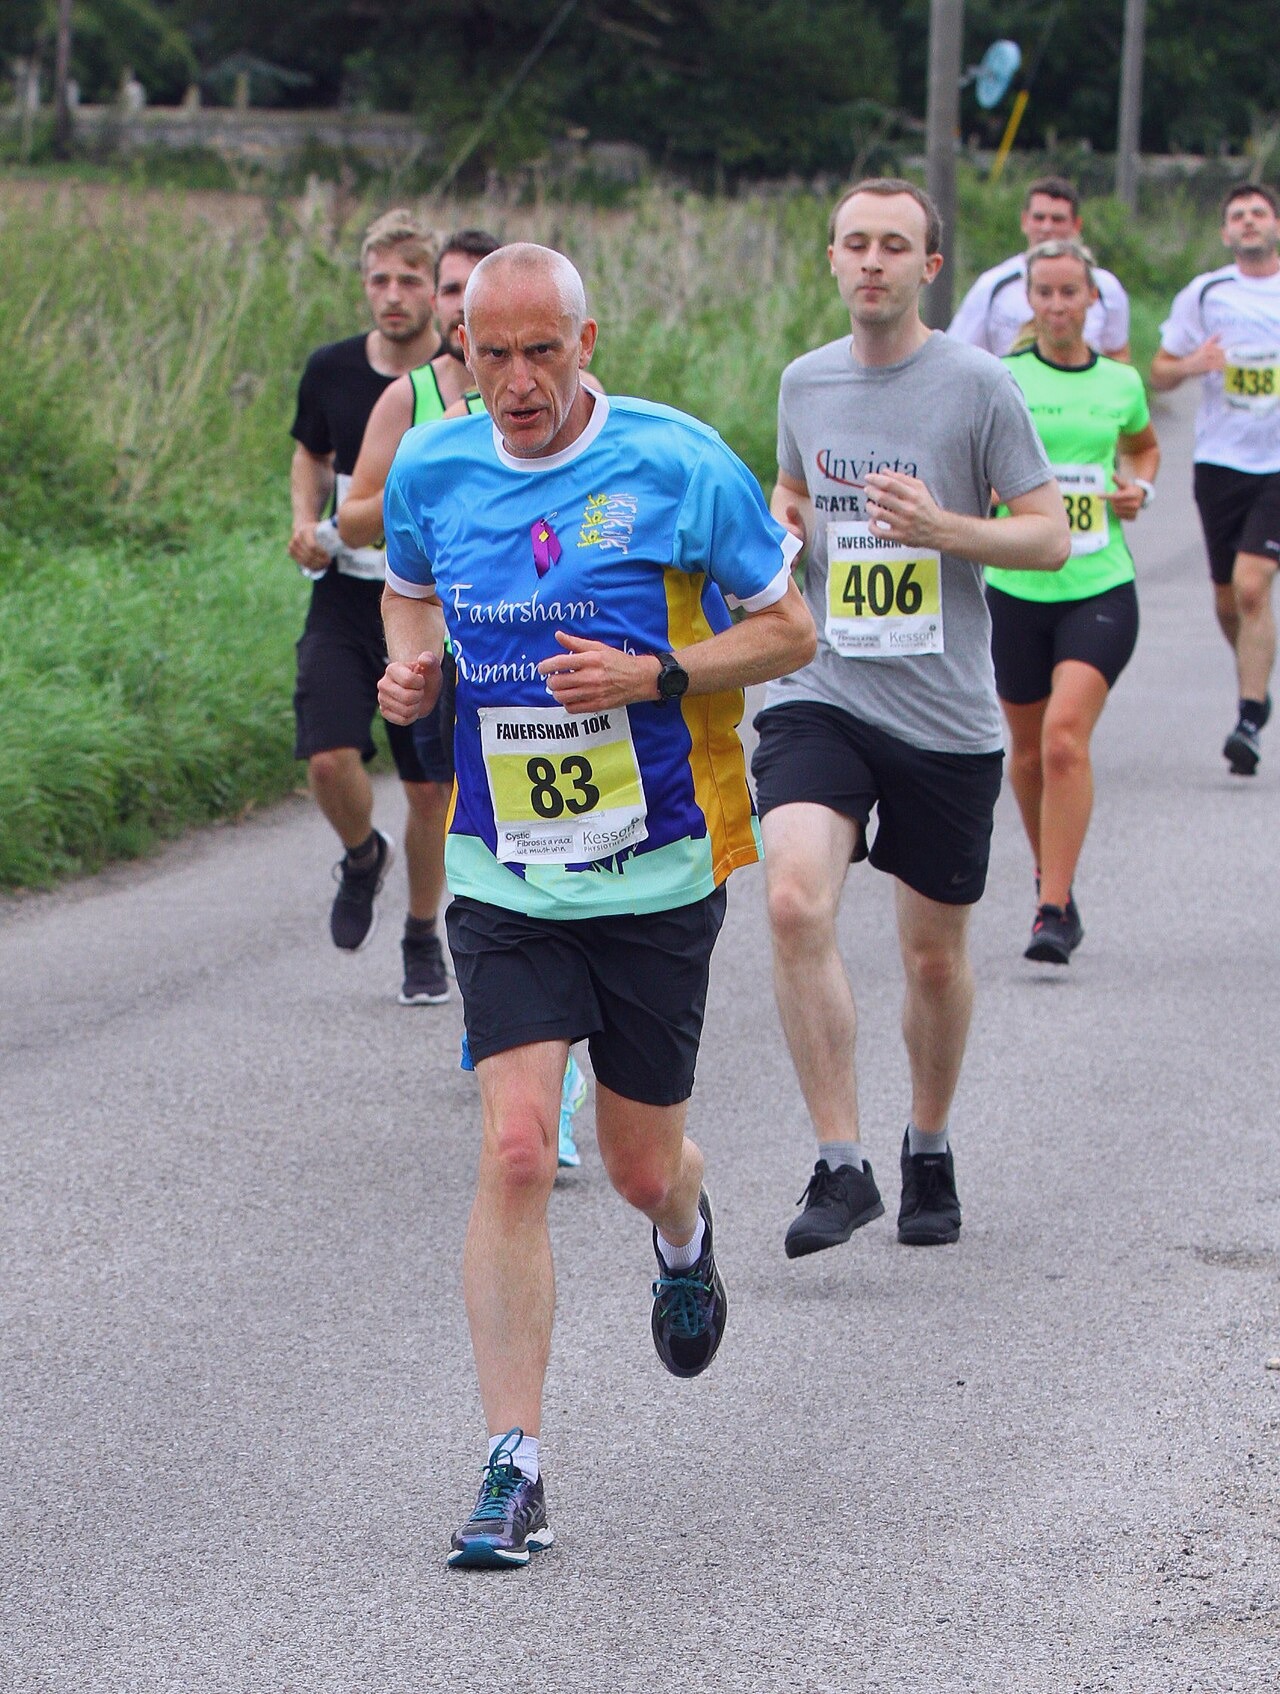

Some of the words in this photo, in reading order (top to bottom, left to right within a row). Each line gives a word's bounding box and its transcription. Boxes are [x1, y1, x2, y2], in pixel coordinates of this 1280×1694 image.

[1233, 367, 1274, 396] 438
[822, 448, 918, 479] Invicta
[448, 584, 599, 624] Faversham
[842, 563, 923, 616] 406
[496, 721, 579, 740] FAVERSHAM
[581, 714, 611, 735] 10K
[526, 755, 600, 819] 83
[505, 831, 530, 842] Cystic
